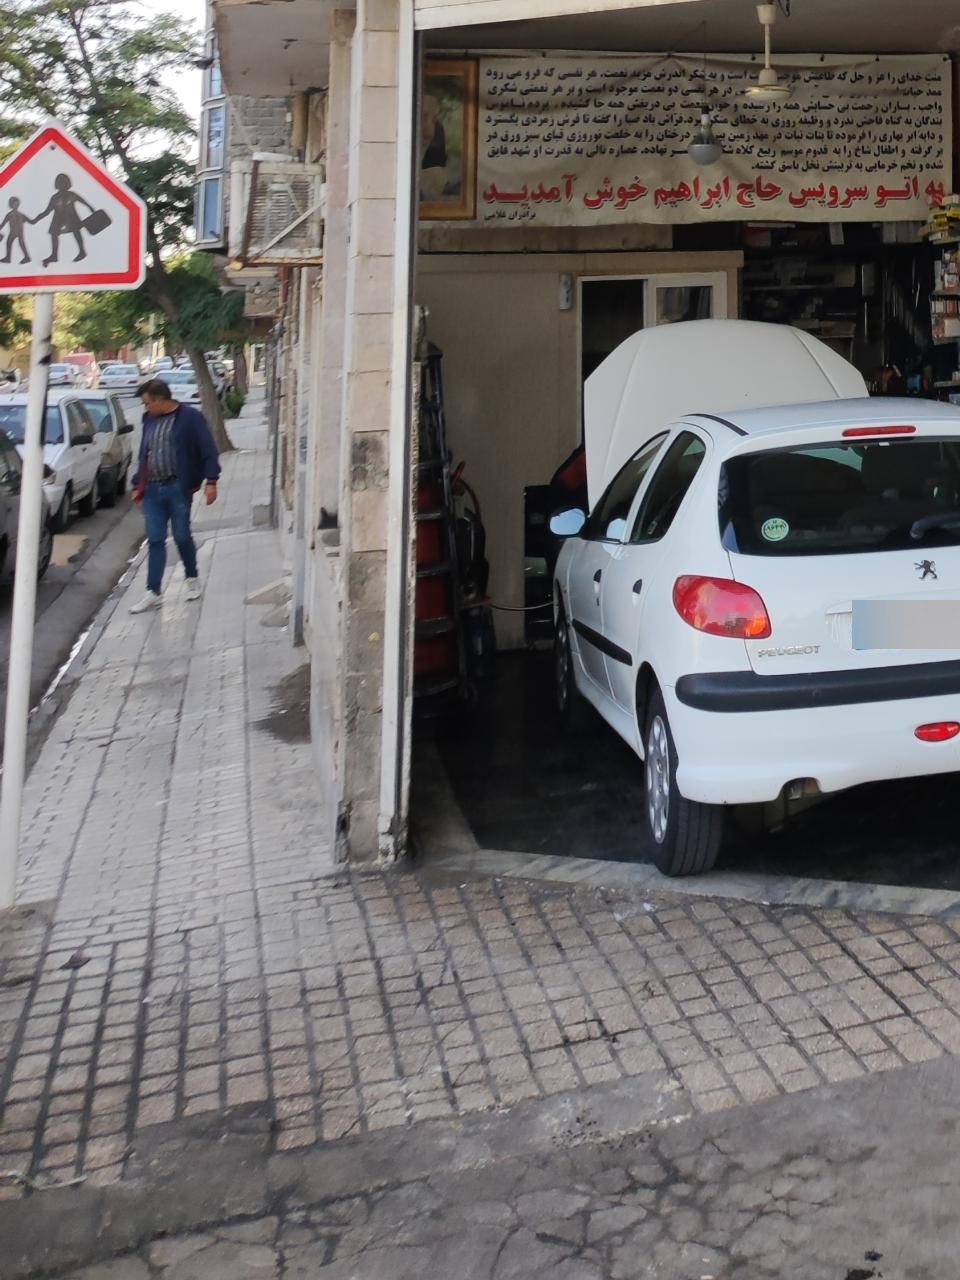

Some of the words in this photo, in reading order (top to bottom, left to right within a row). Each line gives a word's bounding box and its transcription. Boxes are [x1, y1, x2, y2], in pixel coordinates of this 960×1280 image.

[482, 173, 579, 209] آمدید
[583, 175, 648, 209] خوش
[653, 175, 730, 209] ابراهیم
[736, 175, 782, 208] حاج
[788, 181, 868, 209] سرویس
[875, 175, 919, 208] اتو
[757, 645, 821, 658] PEUGEOT
